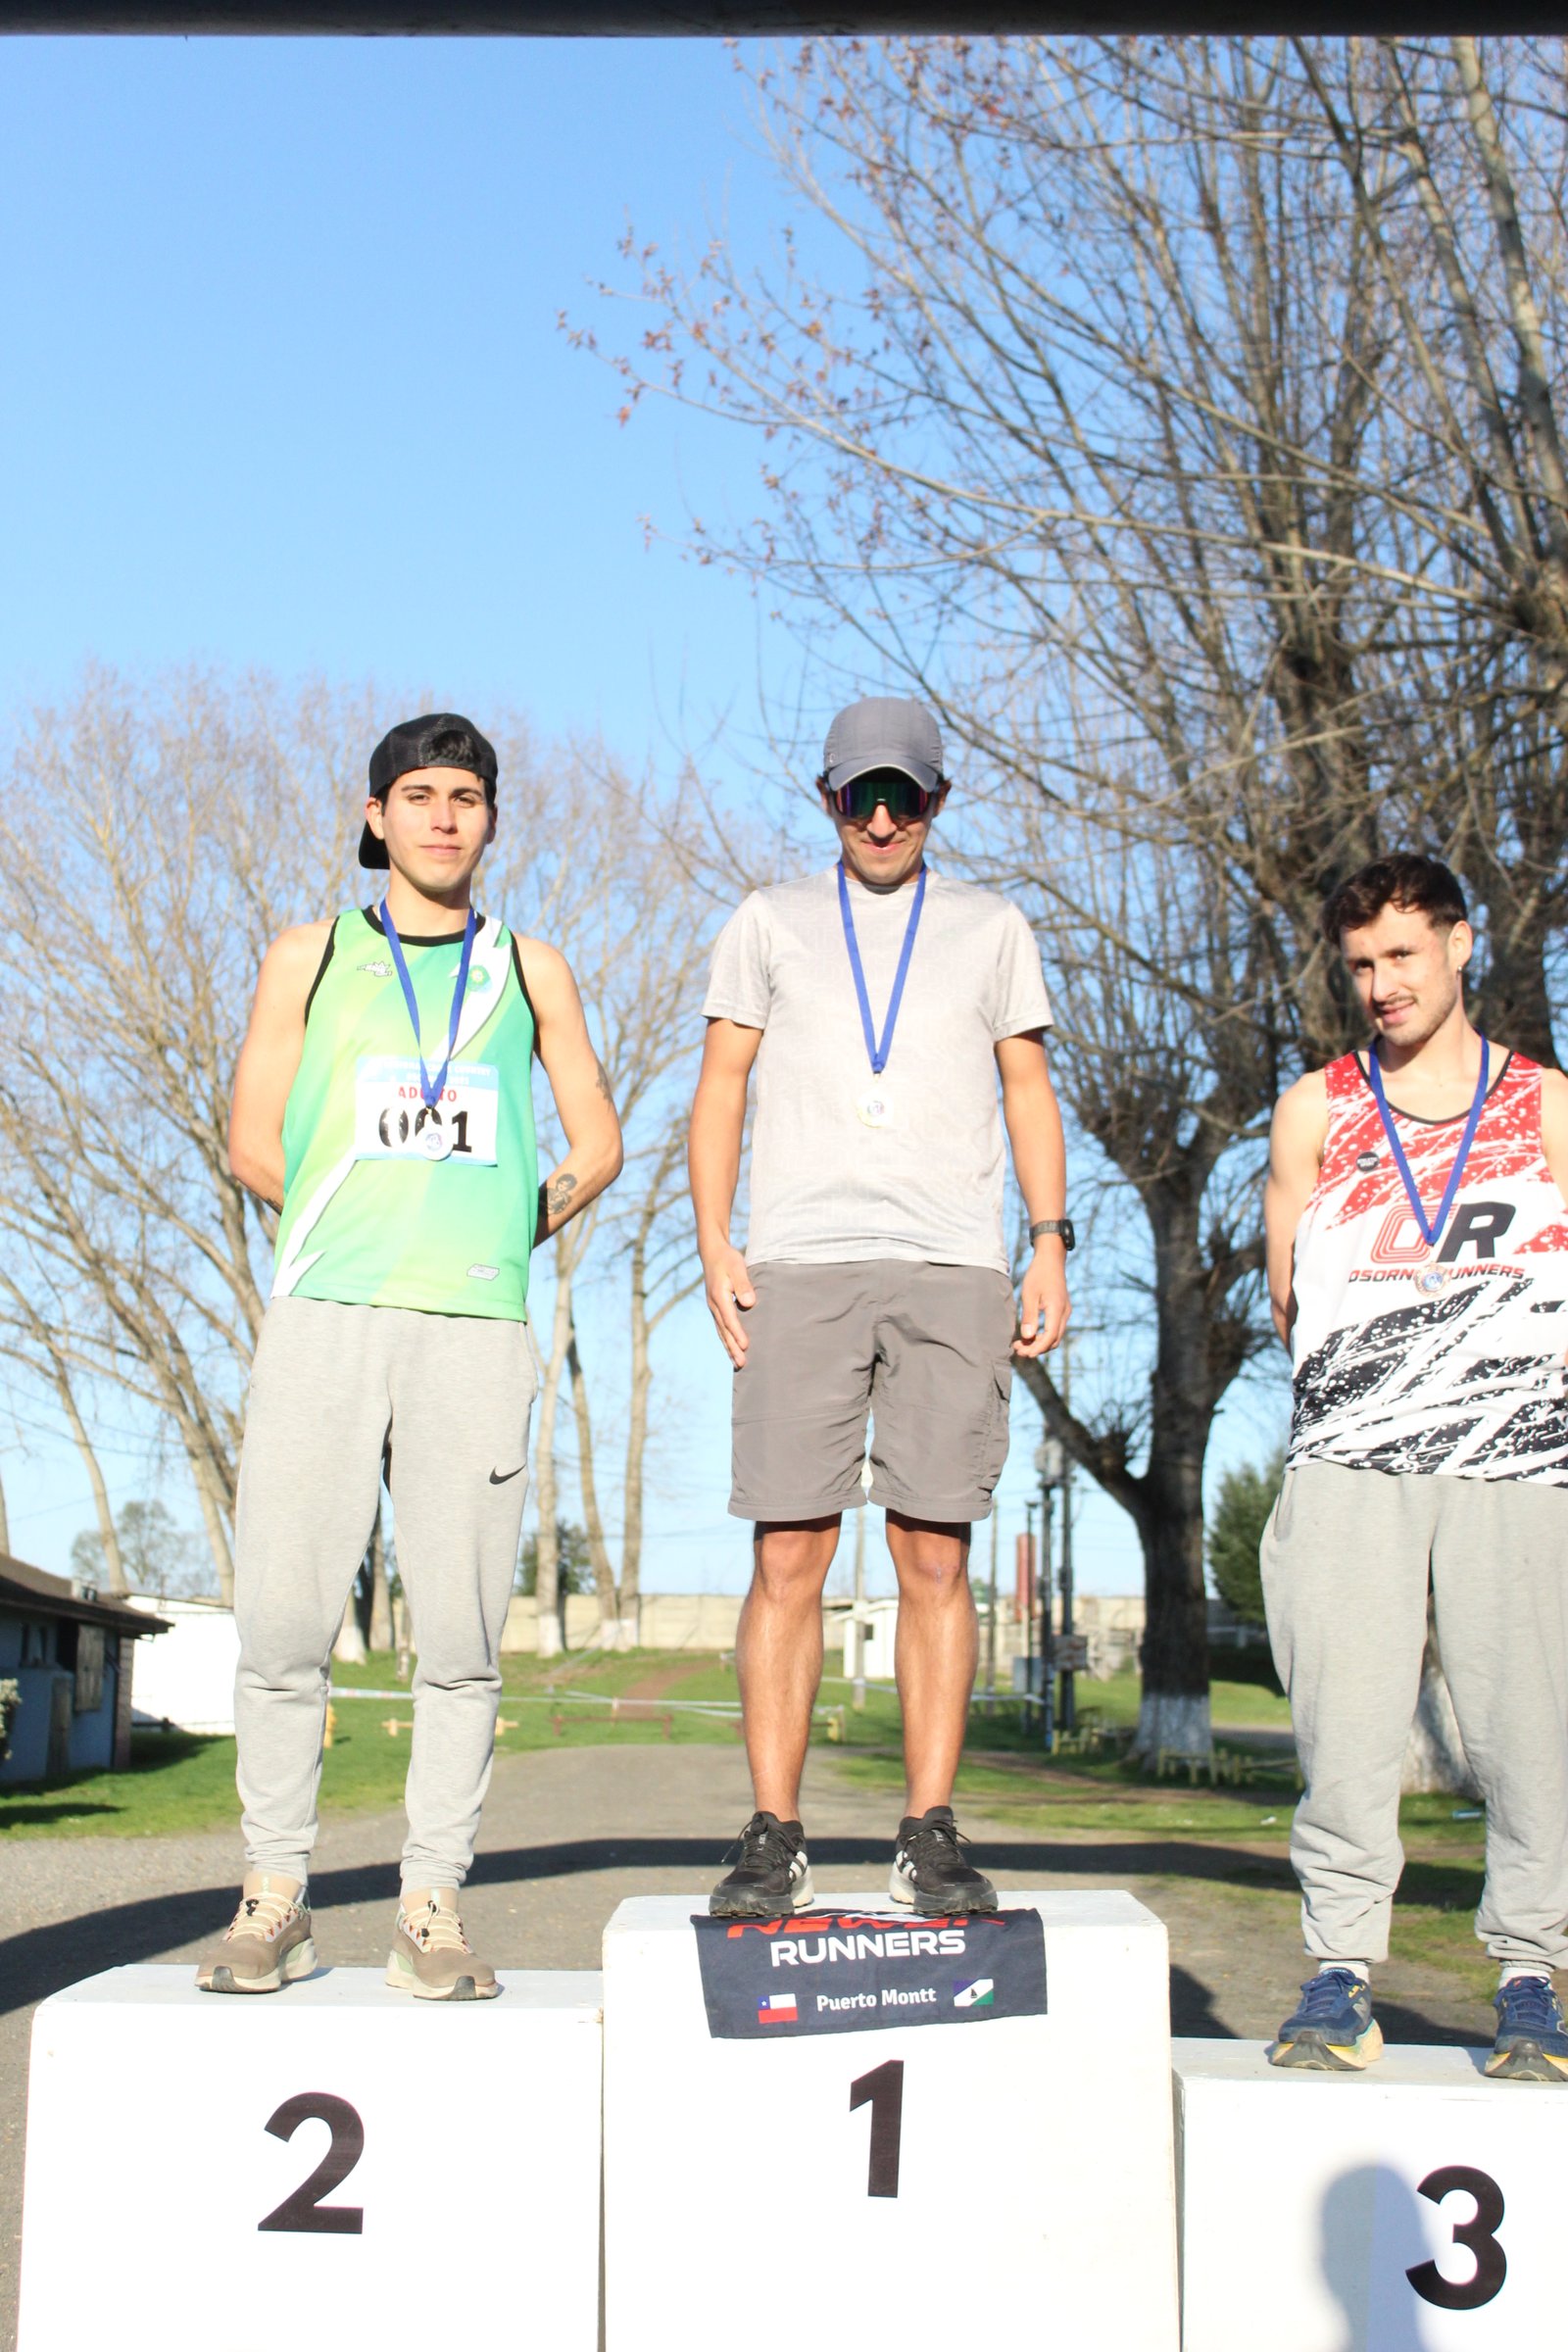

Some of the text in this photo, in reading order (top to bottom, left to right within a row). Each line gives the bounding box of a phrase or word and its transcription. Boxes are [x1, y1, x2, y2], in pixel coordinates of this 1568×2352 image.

[1446, 1263, 1525, 1280] UNNERS
[769, 1930, 966, 1968] RUNNERS
[816, 1987, 937, 2013] Puerto Montt
[257, 2090, 365, 2235] 2
[850, 2059, 905, 2198] 1
[1404, 2165, 1507, 2311] 3
